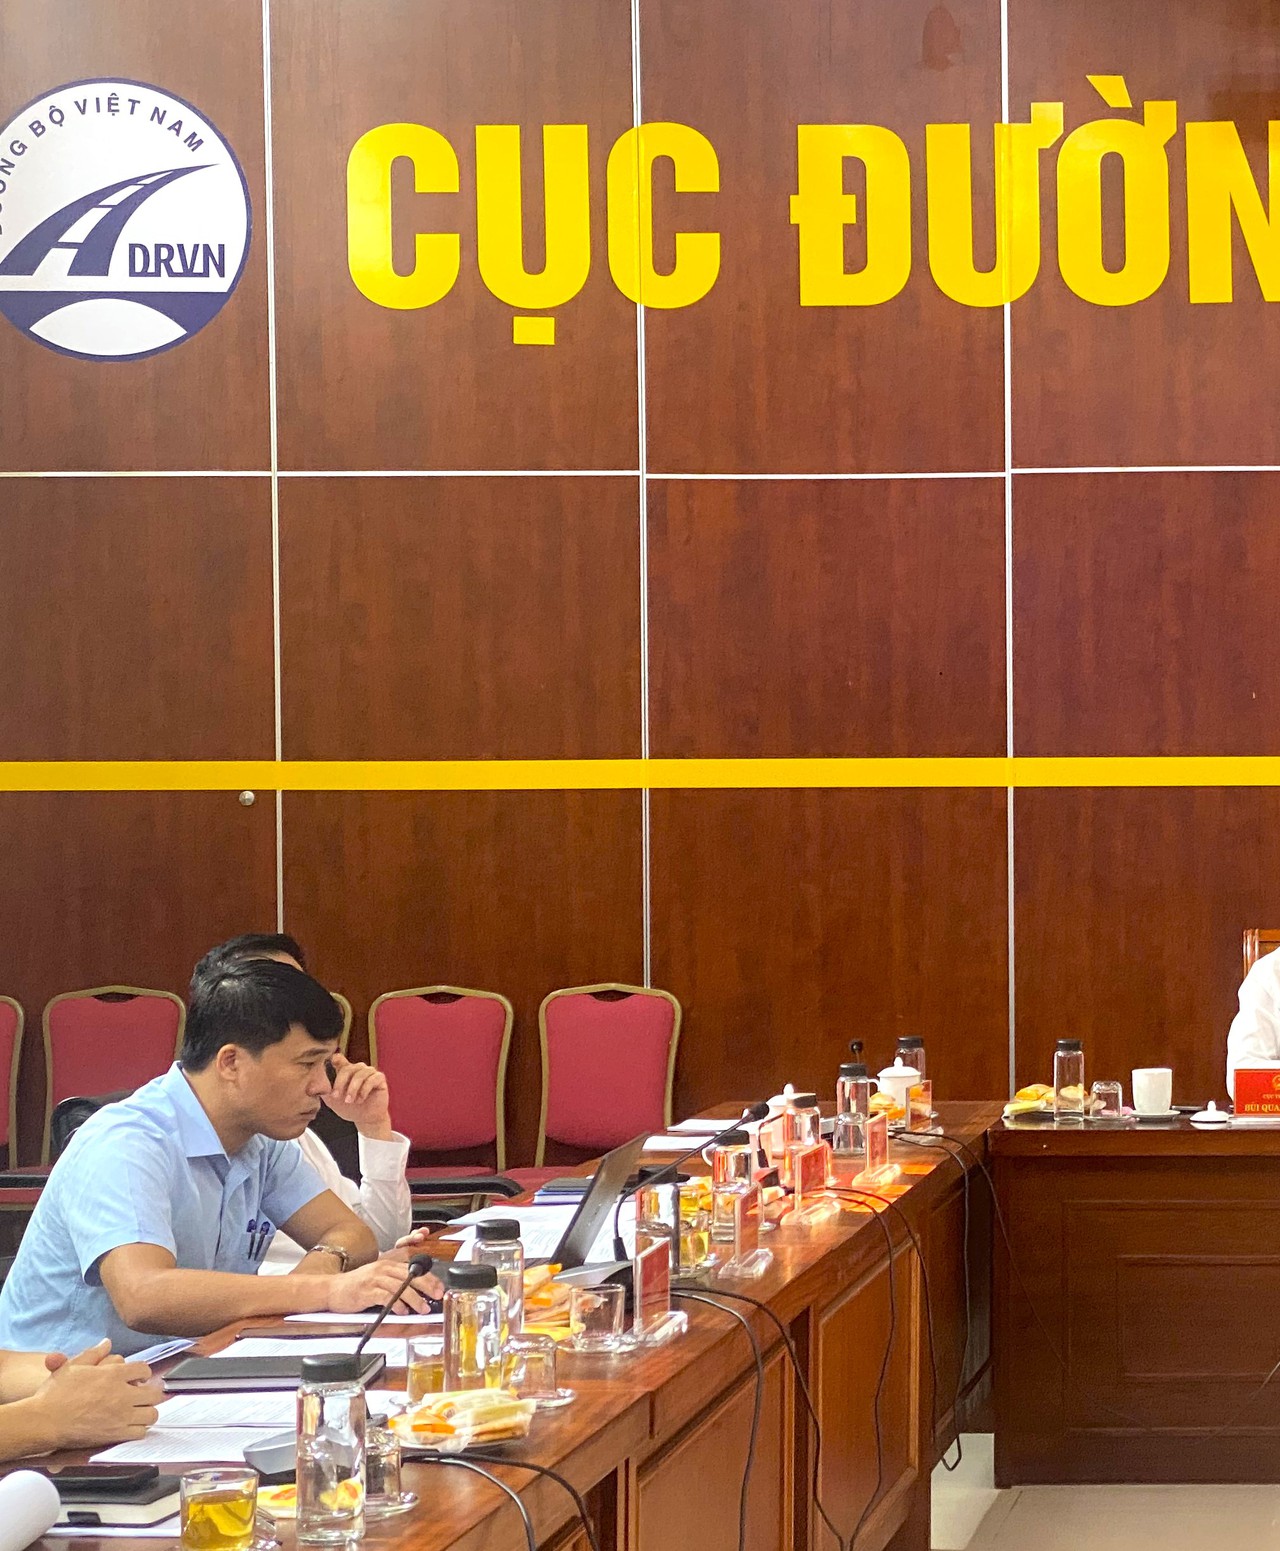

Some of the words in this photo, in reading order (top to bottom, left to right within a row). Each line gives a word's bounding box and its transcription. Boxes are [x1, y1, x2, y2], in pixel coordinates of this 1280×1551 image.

[28, 104, 65, 138] BỘ
[74, 92, 141, 116] VIỆT
[149, 106, 204, 152] NAM
[128, 243, 226, 278] DRVN
[346, 121, 721, 345] CỤC
